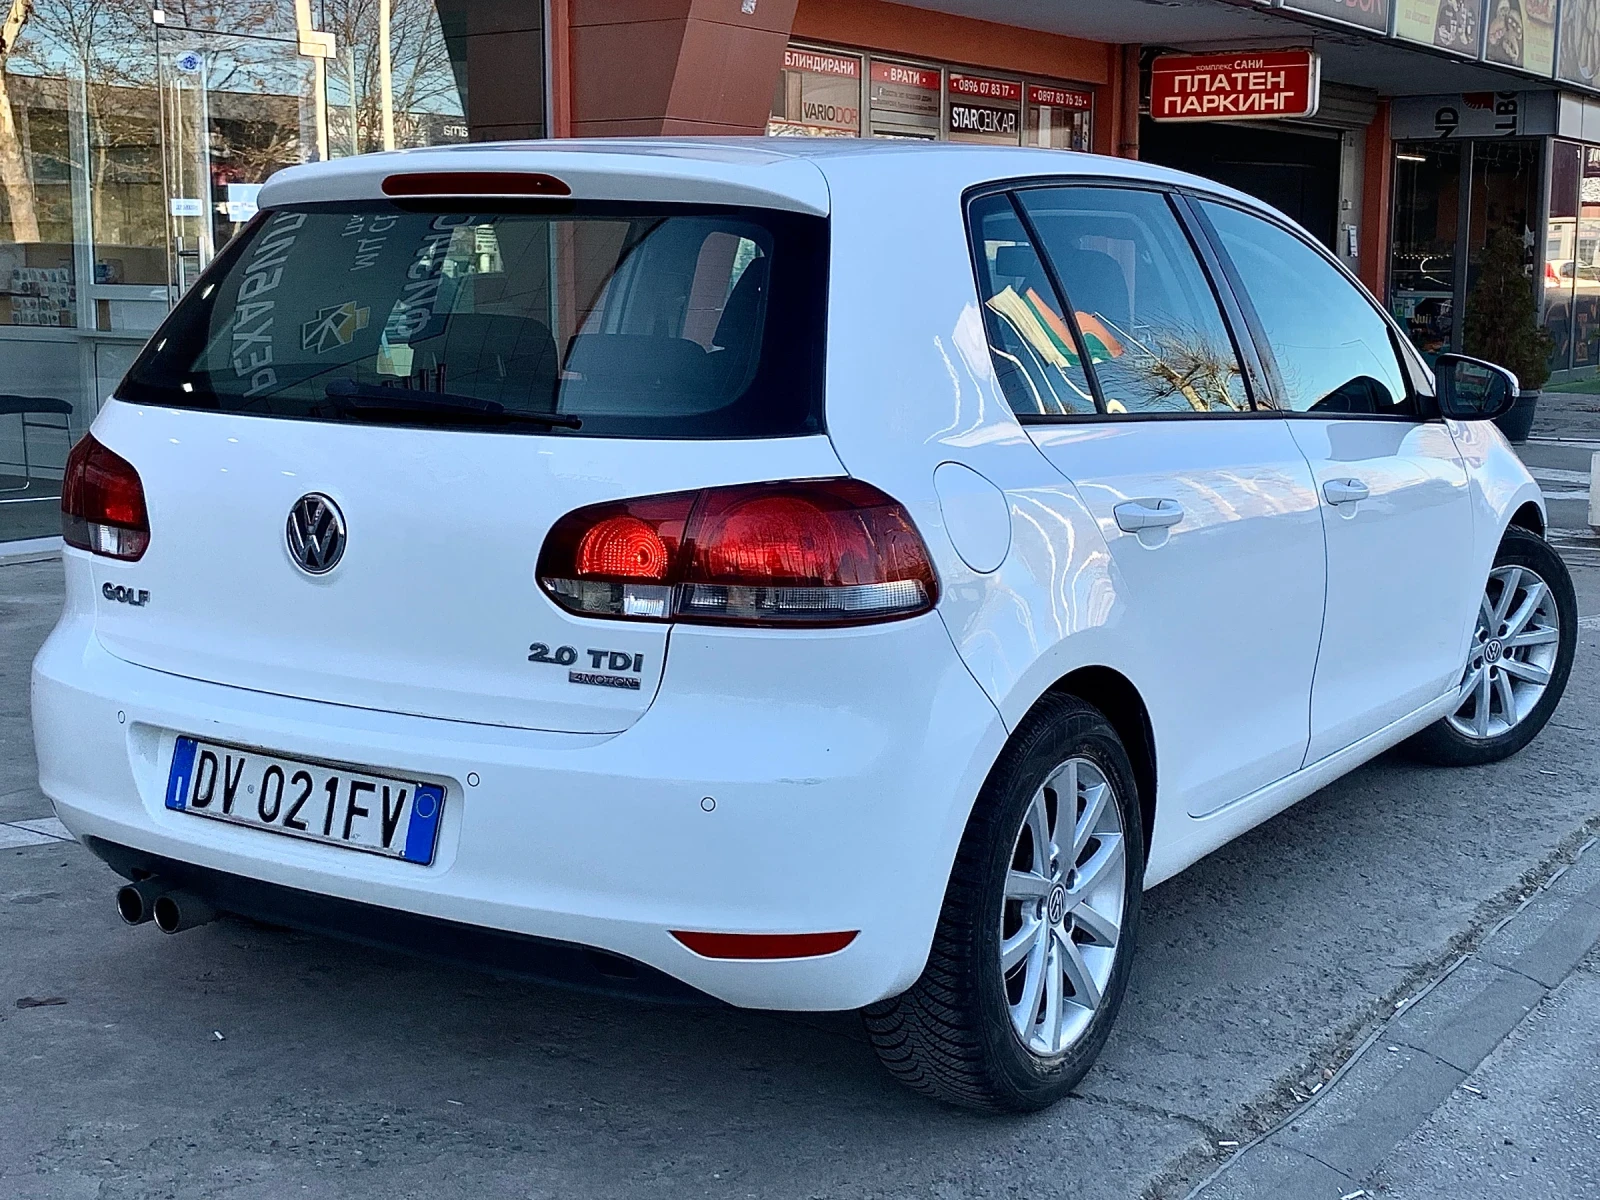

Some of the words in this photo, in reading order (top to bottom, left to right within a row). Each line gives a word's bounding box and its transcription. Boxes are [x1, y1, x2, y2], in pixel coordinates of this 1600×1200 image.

[784, 52, 855, 75] БЛИНДИРАНИ
[1234, 59, 1264, 69] САНИ
[890, 68, 920, 84] ВРАТИ
[1174, 71, 1286, 93] ПЛАТЕН
[958, 80, 979, 92] 0896
[980, 82, 989, 94] 07
[991, 83, 1000, 95] 83
[1001, 84, 1010, 96] 17
[1037, 90, 1055, 102] 0897
[1055, 92, 1064, 104] 82
[1164, 92, 1294, 114] ПАРКИНГ
[102, 582, 150, 607] GOLF
[528, 642, 579, 666] 2.0
[587, 648, 645, 673] TDI
[192, 750, 246, 815] DV
[257, 764, 408, 849] 021FV
